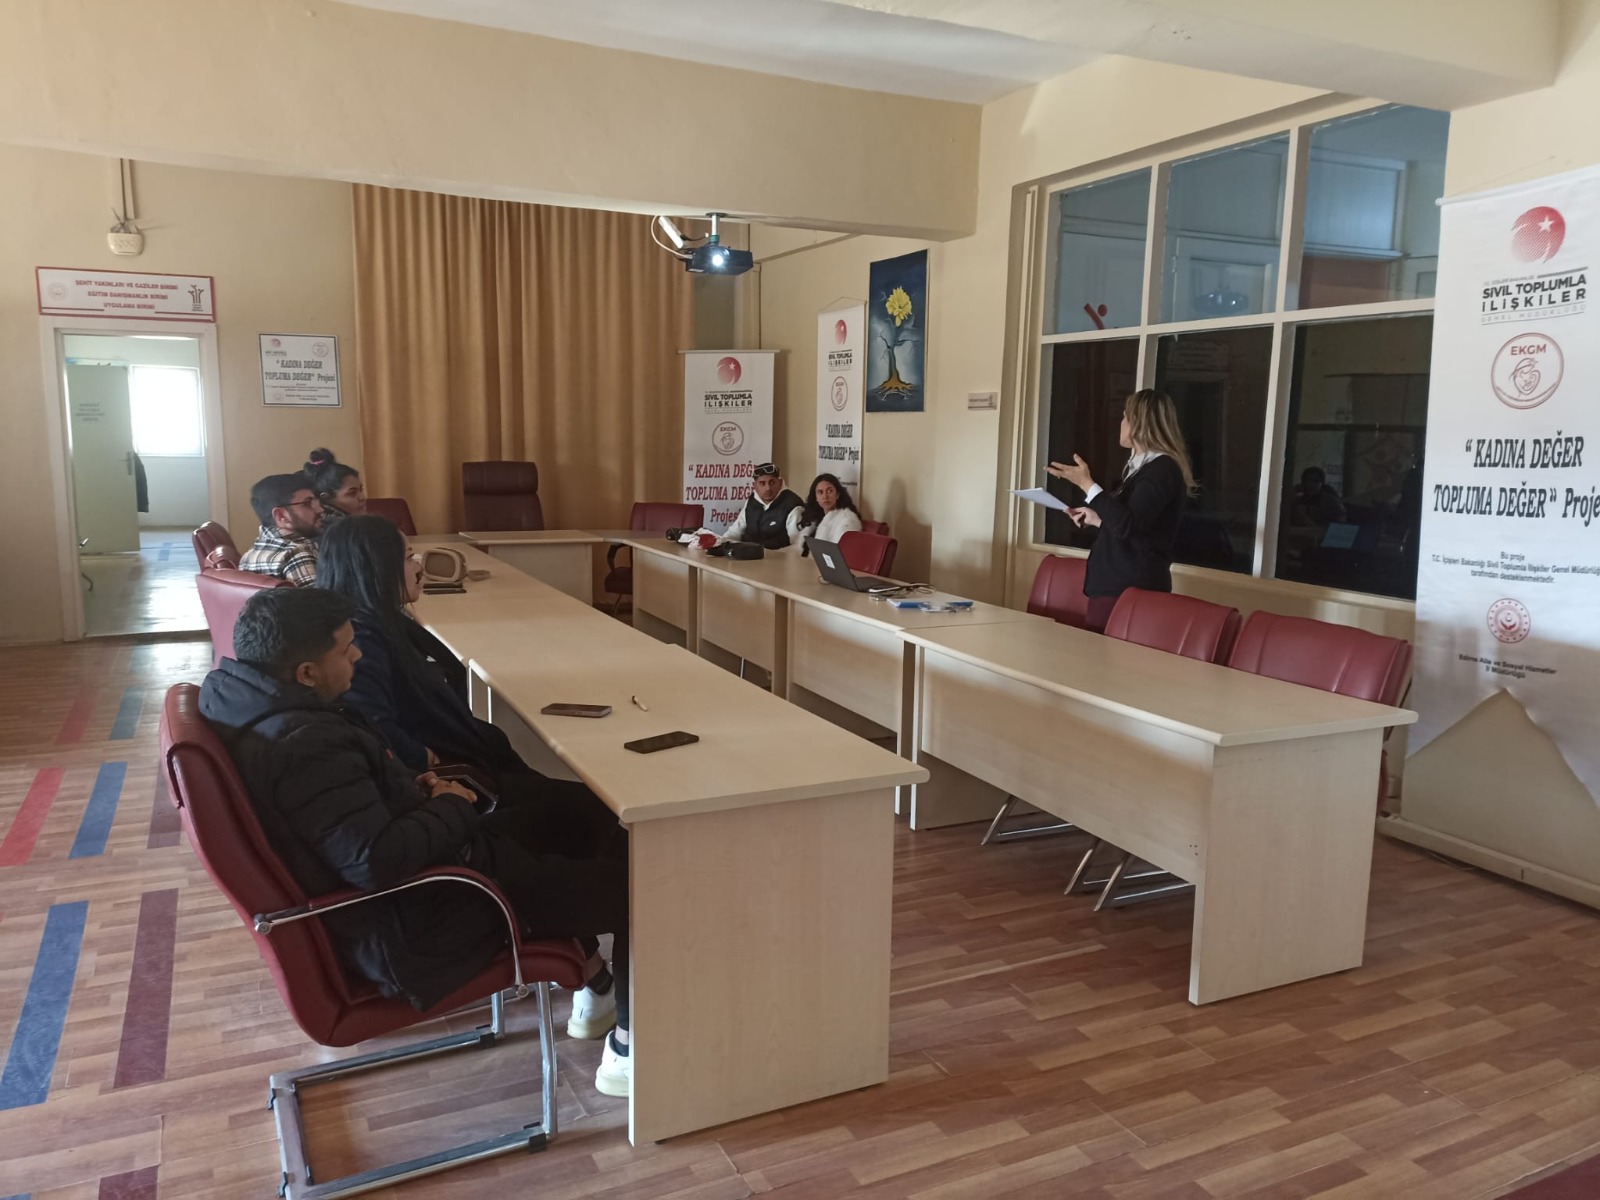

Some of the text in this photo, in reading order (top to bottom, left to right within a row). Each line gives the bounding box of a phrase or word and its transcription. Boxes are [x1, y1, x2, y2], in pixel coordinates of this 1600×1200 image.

[1482, 274, 1587, 299] SİVİL TOPLUMLA
[1482, 288, 1586, 312] İLİŞKİLER
[1510, 344, 1547, 356] EKGM
[281, 360, 302, 368] KADINA
[304, 359, 323, 369] DEĞER
[265, 372, 292, 380] TOPLUMA
[317, 373, 336, 384] Projesi
[1474, 438, 1526, 468] KADINA
[1530, 430, 1584, 468] DEĞER
[695, 464, 730, 478] KADINA
[733, 460, 757, 478] DEĞ
[686, 483, 754, 500] TOPLUMA DEĞ
[1434, 484, 1492, 516] TOPLUMA
[1562, 486, 1600, 527] Proje
[1500, 551, 1525, 562] Bu proje
[1471, 570, 1498, 578] tarafından
[1486, 560, 1499, 568] Sivil
[1500, 562, 1526, 571] Toplumla
[1552, 565, 1570, 573] Genel
[1459, 654, 1478, 662] Edirne
[1502, 661, 1524, 670] Sosyal
[1525, 665, 1557, 674] Hizmetler
